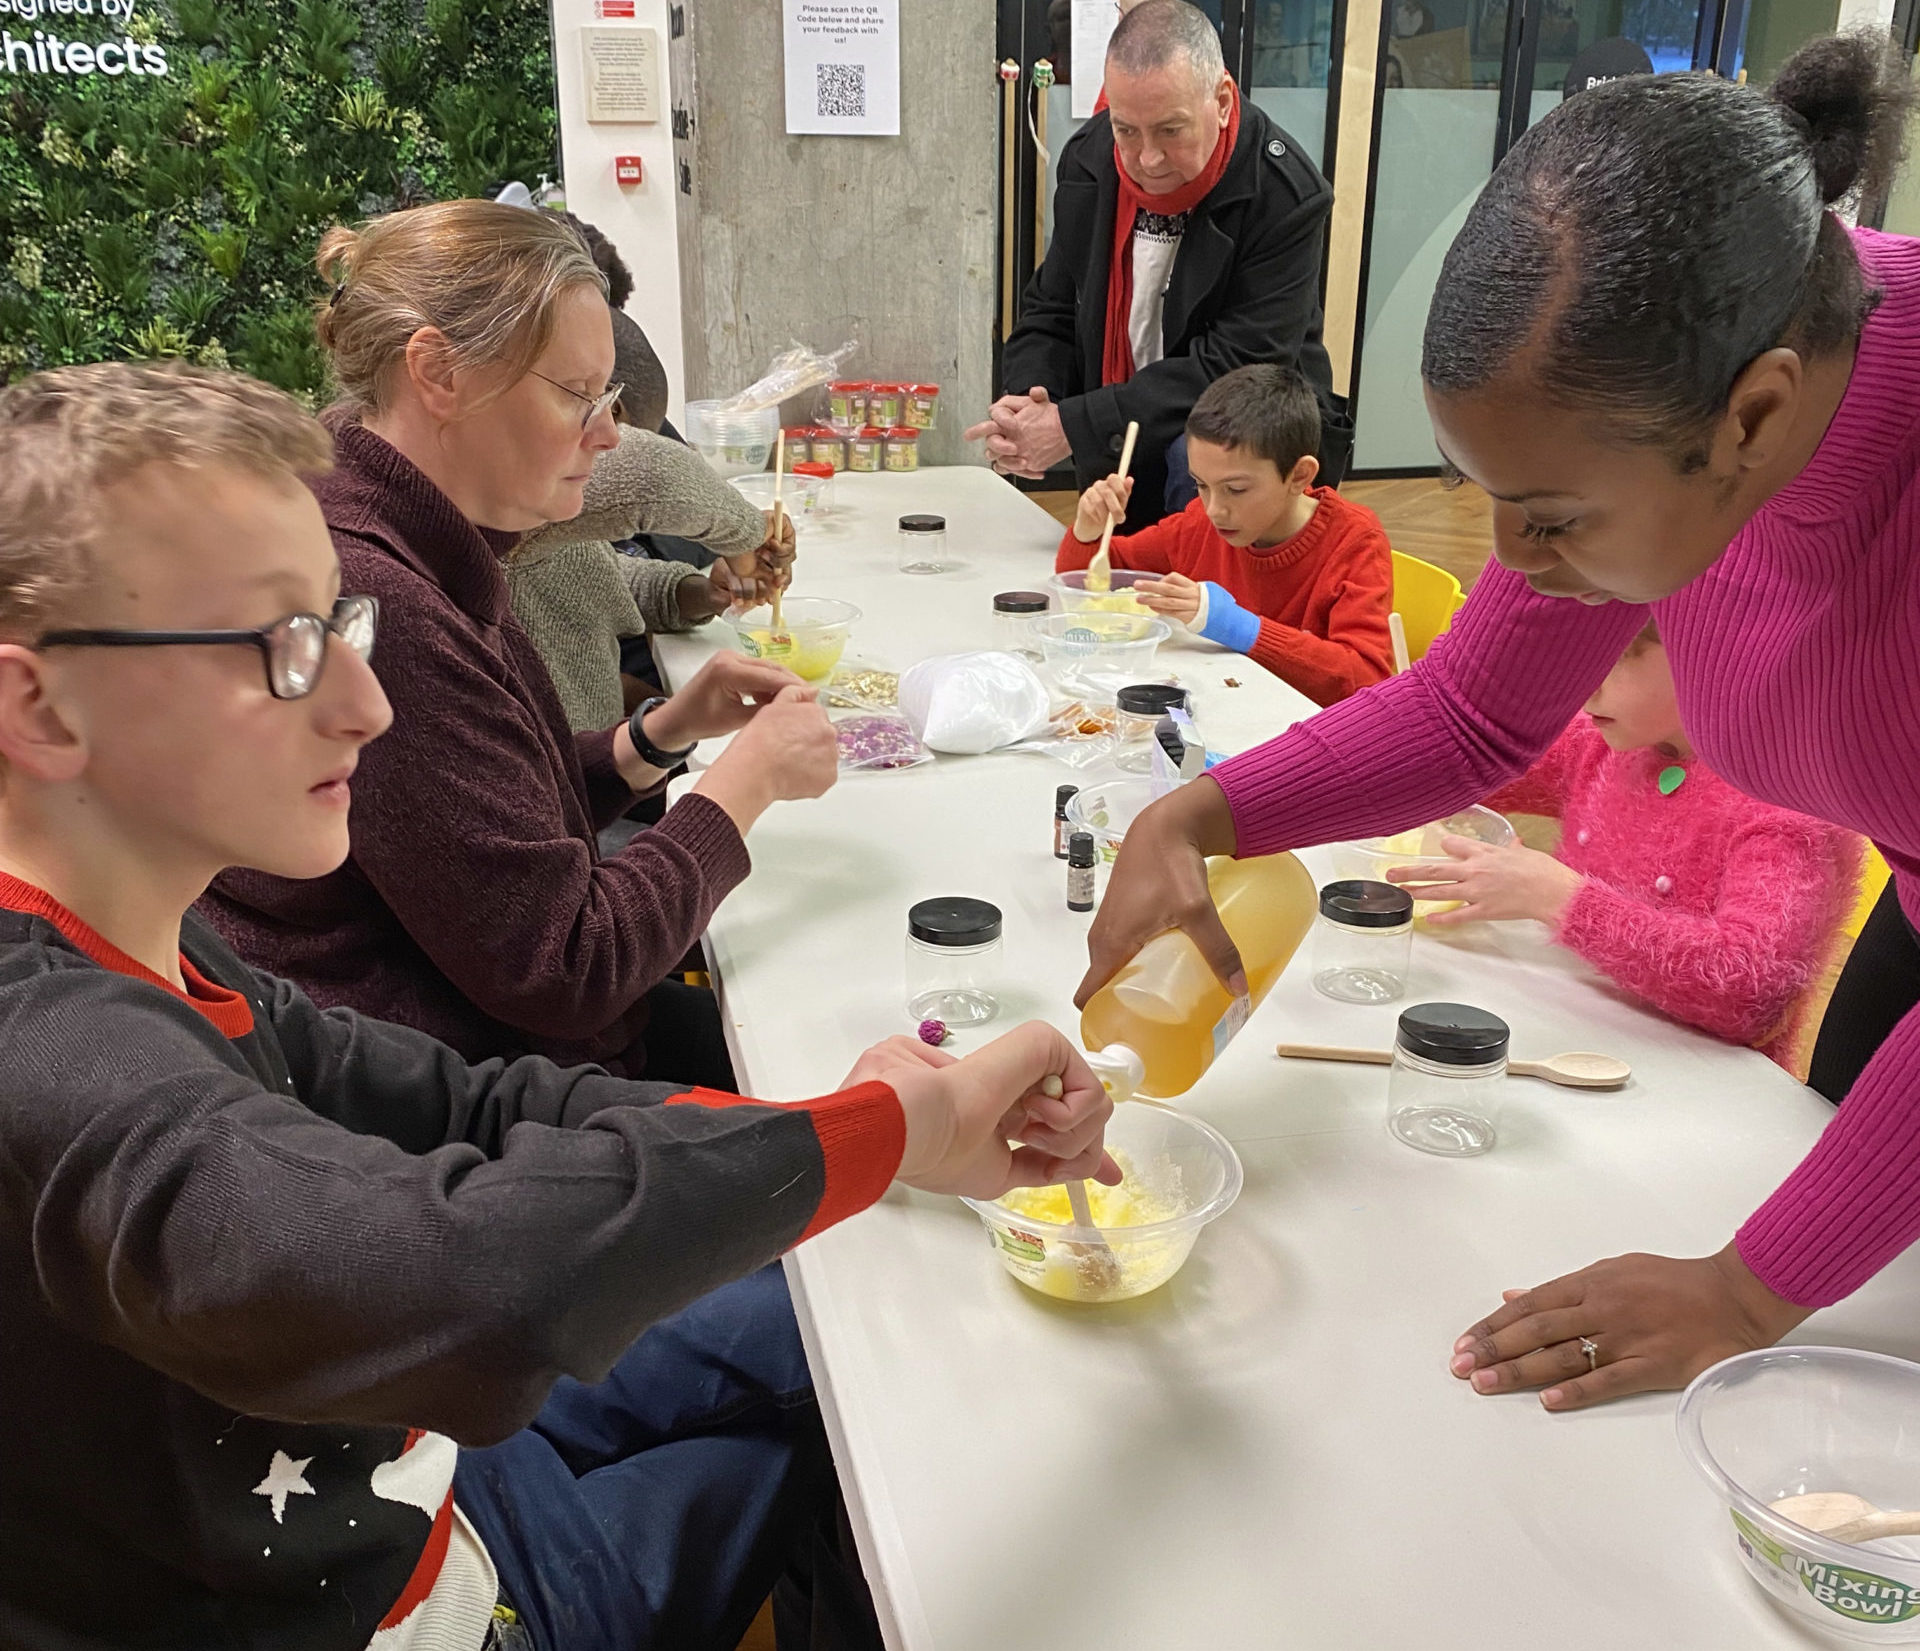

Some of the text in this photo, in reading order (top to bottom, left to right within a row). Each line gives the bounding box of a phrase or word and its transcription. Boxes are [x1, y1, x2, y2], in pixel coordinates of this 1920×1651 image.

[802, 4, 829, 13] Please
[866, 6, 878, 15] QR
[796, 14, 884, 24] Code below and share
[802, 25, 879, 34] your feedback with
[834, 36, 847, 44] us!
[0, 30, 168, 76] hitects
[1795, 1555, 1920, 1605] Mixing
[1813, 1582, 1903, 1617] Bowl
